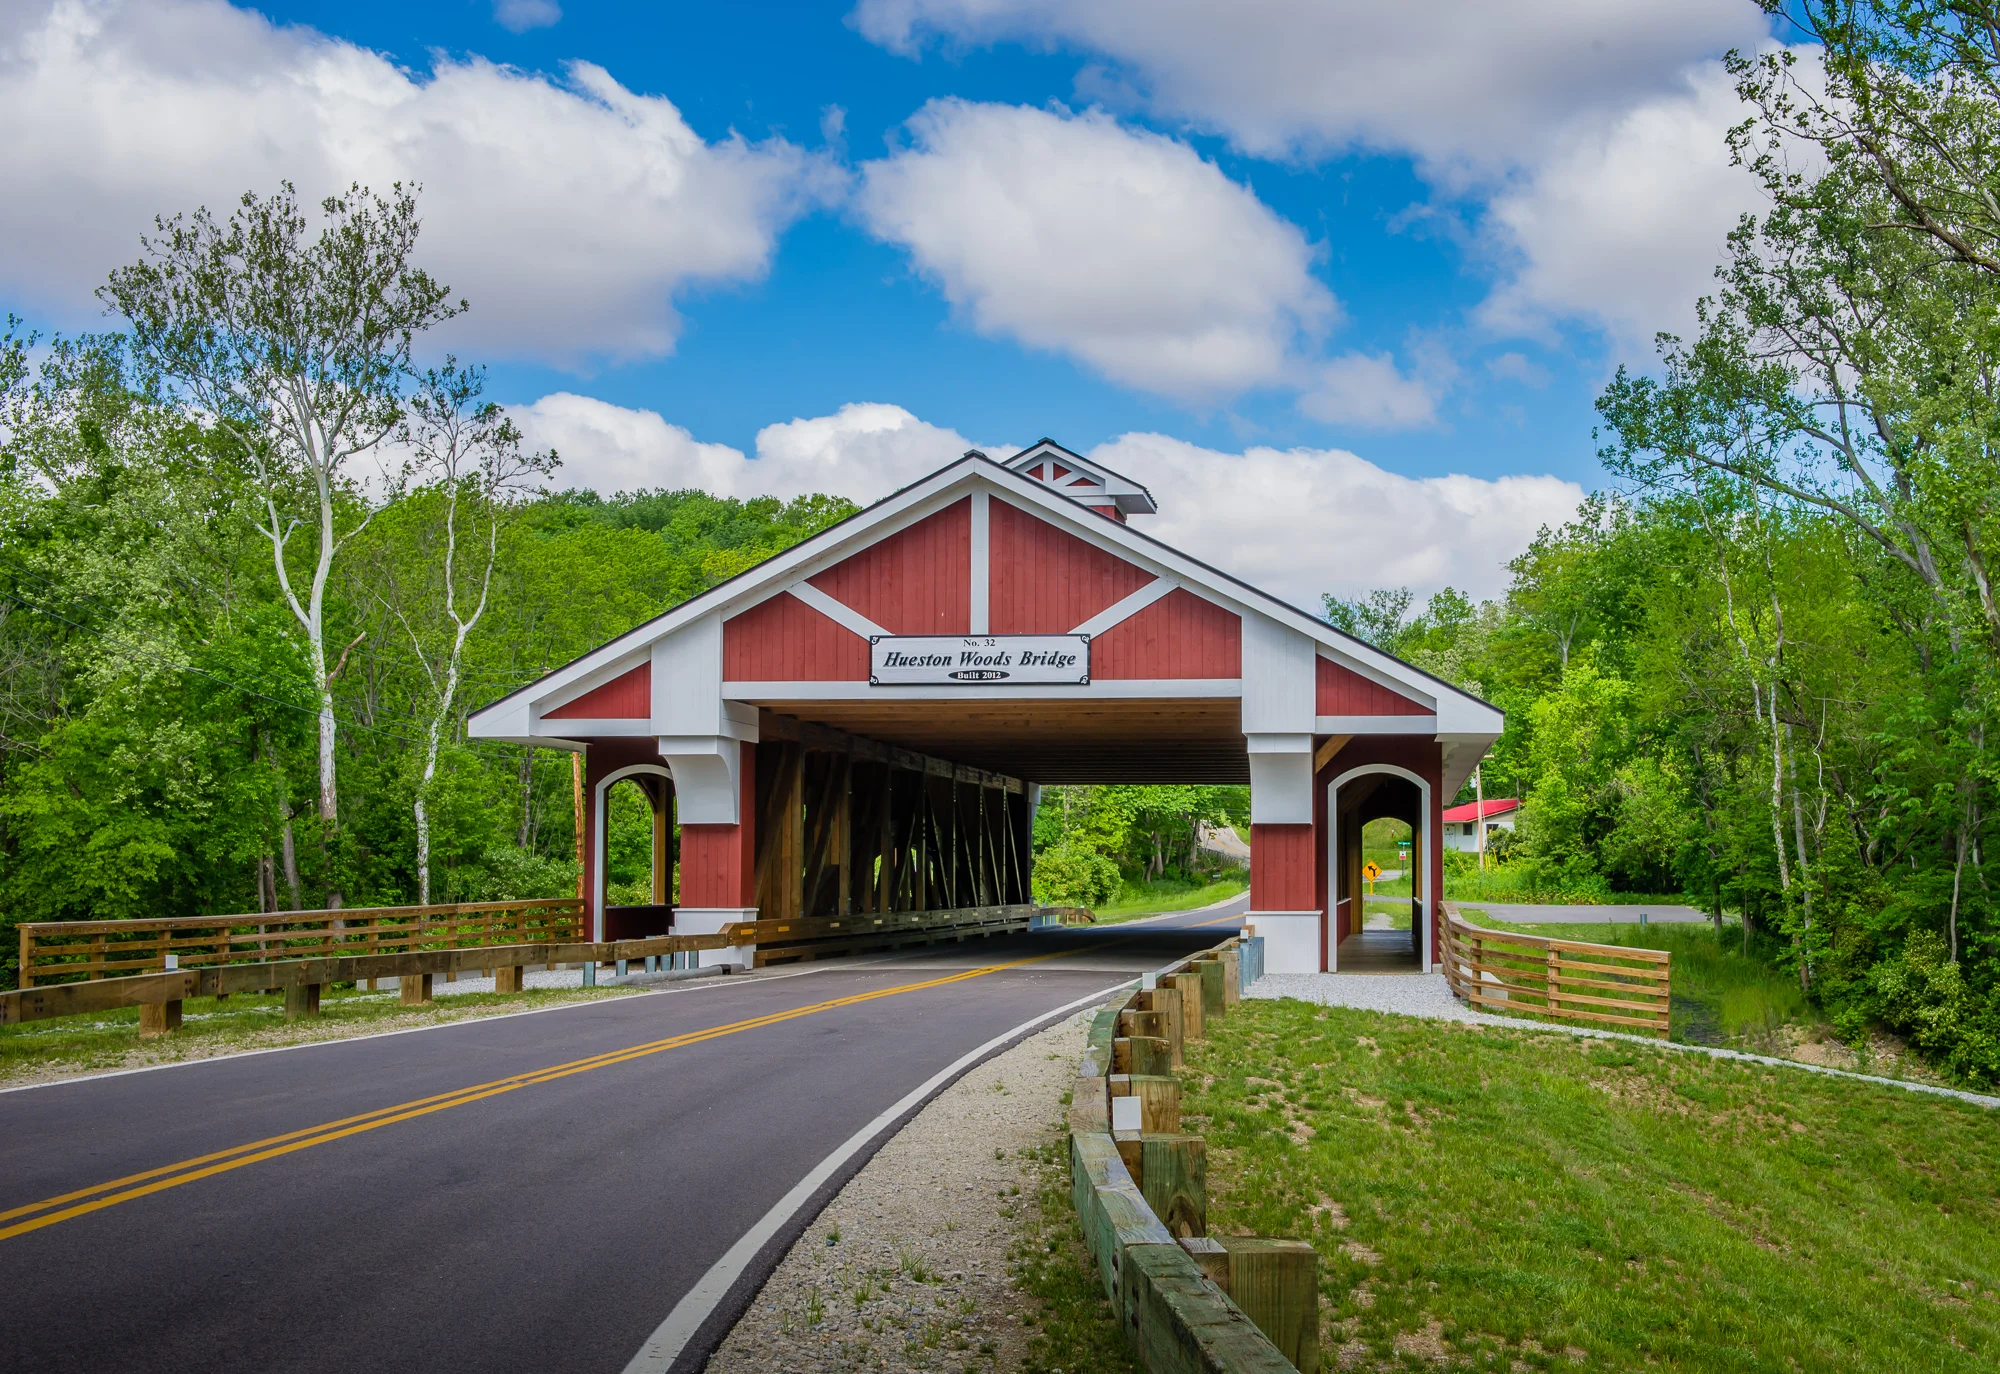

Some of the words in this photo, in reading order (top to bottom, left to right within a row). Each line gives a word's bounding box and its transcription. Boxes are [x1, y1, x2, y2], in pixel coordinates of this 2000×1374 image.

[963, 638, 980, 647] No.
[984, 638, 996, 647] 32
[883, 651, 953, 667] Hueston
[959, 651, 1012, 667] Woods
[1018, 650, 1077, 669] Bridge
[957, 671, 980, 679] Built
[982, 671, 1002, 679] 2012
